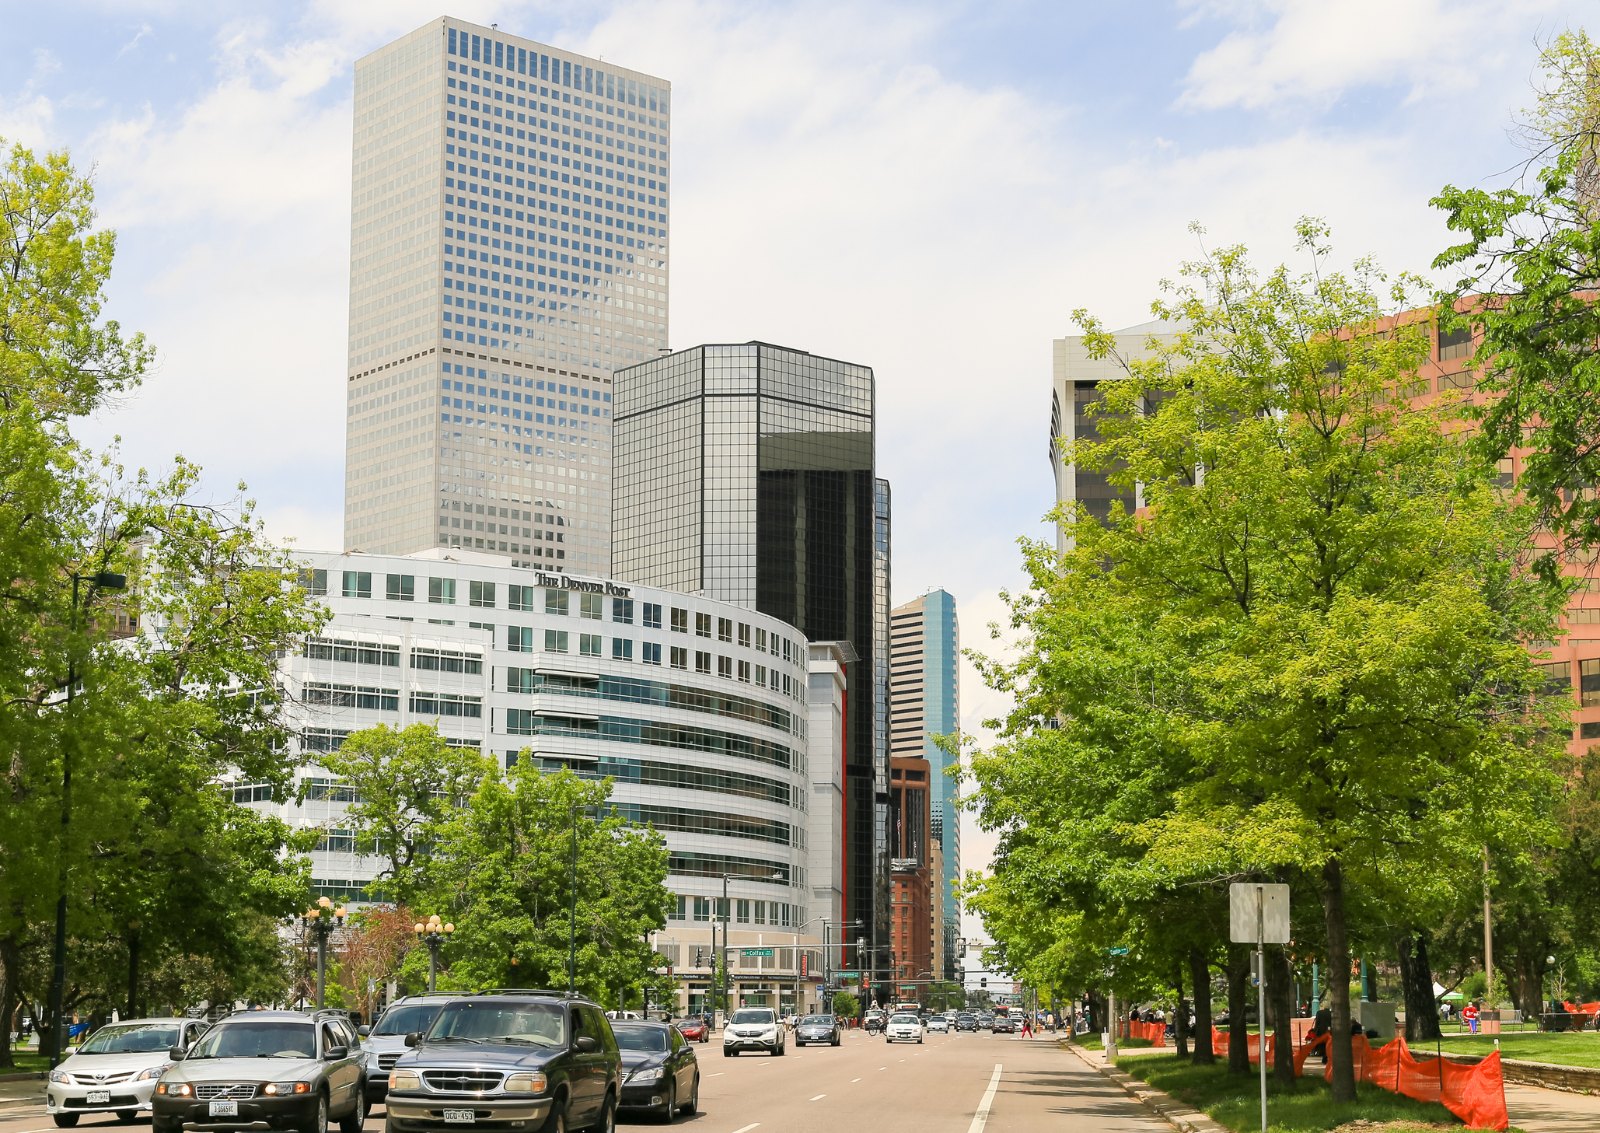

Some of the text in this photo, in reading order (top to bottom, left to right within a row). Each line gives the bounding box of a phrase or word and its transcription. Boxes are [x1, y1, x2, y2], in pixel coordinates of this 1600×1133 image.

[535, 572, 631, 597] THE DENVER POST
